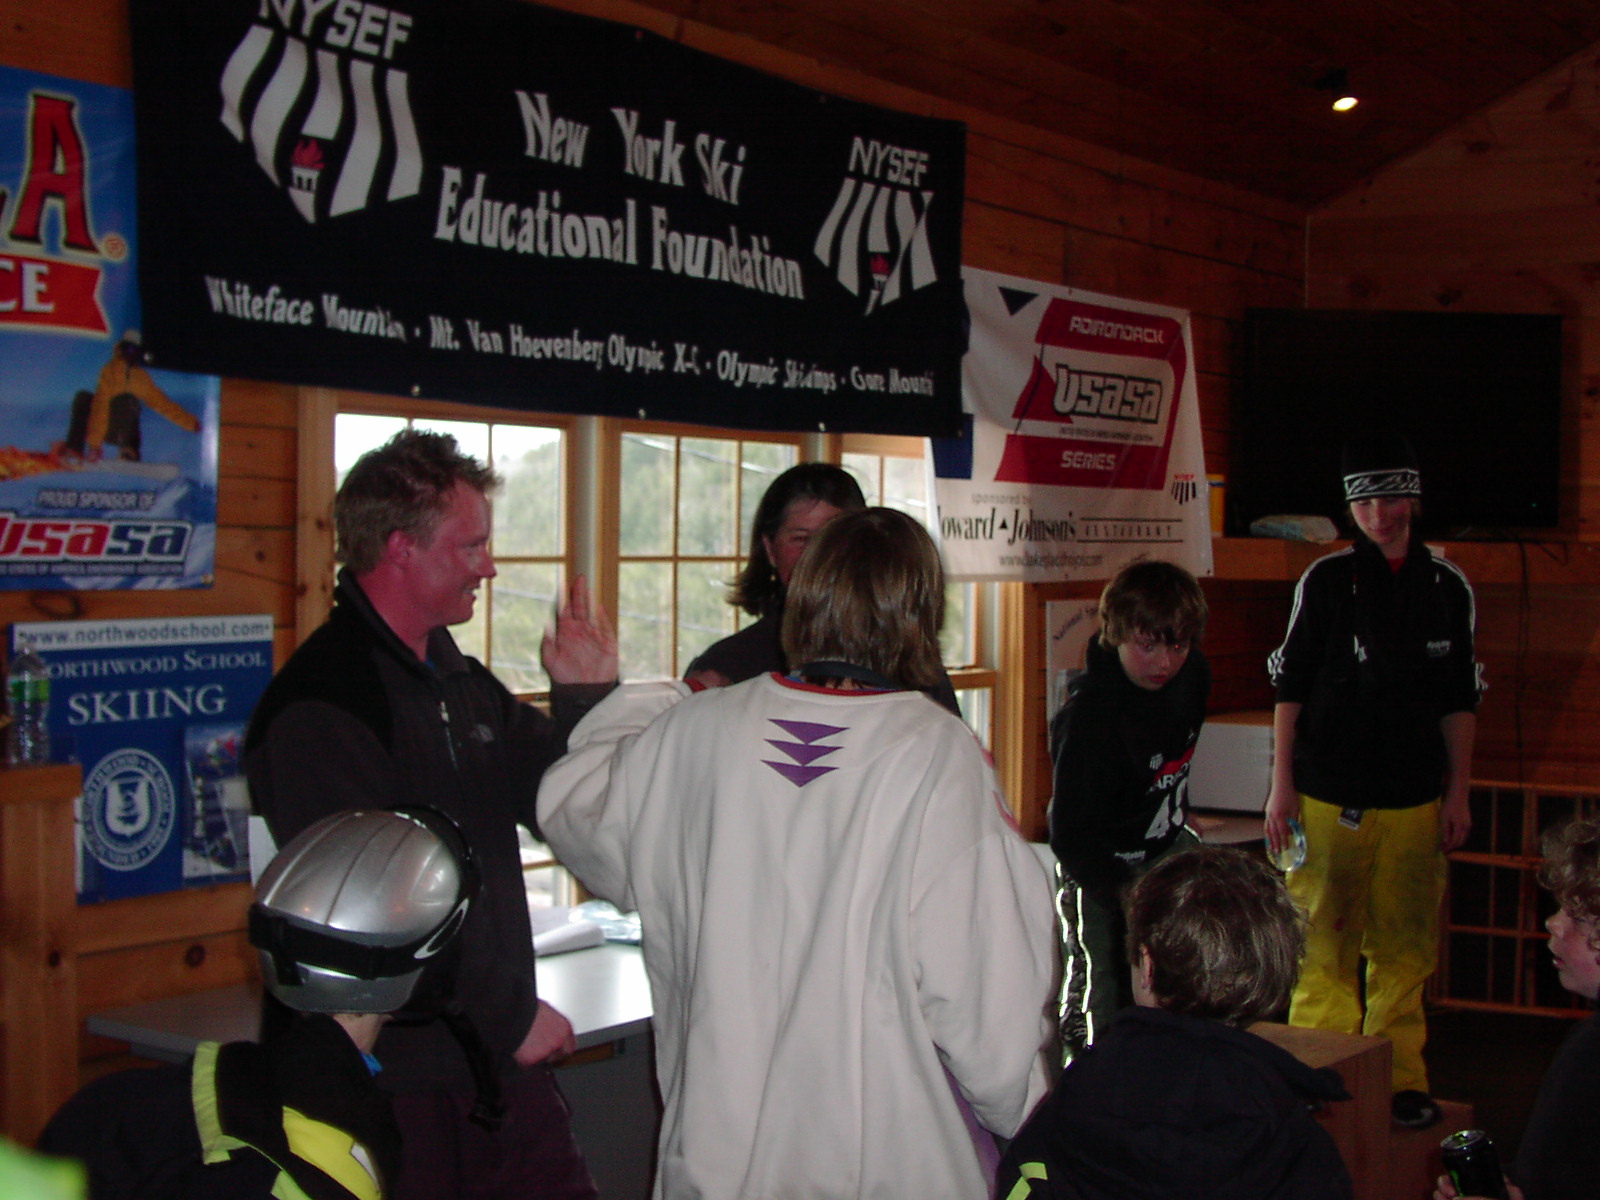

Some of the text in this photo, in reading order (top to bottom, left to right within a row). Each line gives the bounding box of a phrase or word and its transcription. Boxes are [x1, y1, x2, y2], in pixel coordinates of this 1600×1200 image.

[259, 0, 413, 60] NYSEF
[514, 90, 746, 205] New York Ski
[848, 136, 929, 187] NYSEF
[434, 166, 805, 300] Educational Foundation
[205, 275, 315, 326] Whiteface
[429, 315, 461, 351] Mt.
[466, 319, 505, 354] Van
[607, 333, 666, 374] Olympic
[716, 349, 779, 388] Olympic
[1069, 315, 1165, 345] ADIRONDACK
[1060, 450, 1117, 472] SERIES
[67, 683, 227, 726] SKIING
